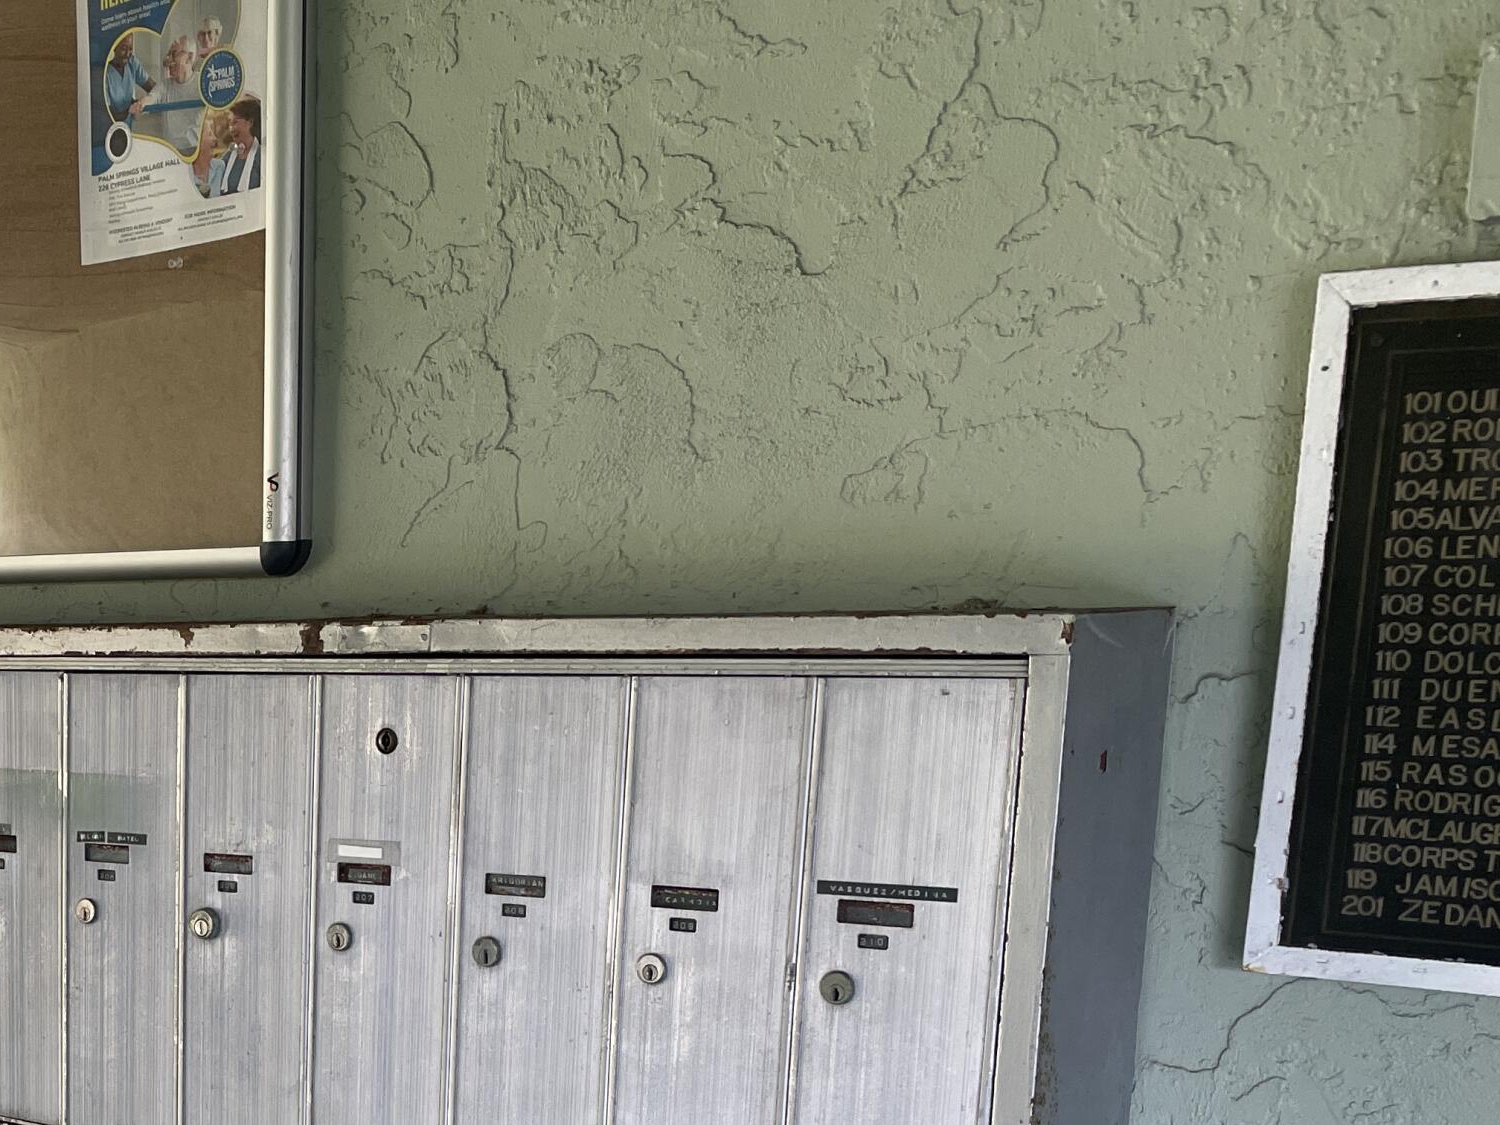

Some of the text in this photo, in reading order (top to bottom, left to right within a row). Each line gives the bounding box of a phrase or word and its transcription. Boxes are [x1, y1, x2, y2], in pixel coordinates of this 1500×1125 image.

[218, 65, 235, 77] PALM
[211, 78, 235, 92] SPRINGS
[98, 158, 180, 182] PALM SPRINGS VILLAGE HALL
[110, 178, 135, 189] CYPRESS
[136, 174, 151, 183] LANE
[1404, 391, 1442, 415] 101
[1402, 420, 1446, 444] 102
[1400, 449, 1443, 473] 103
[1395, 478, 1440, 502] 104
[1391, 505, 1500, 531] 105 ALVA
[1384, 536, 1433, 559] 106
[1385, 564, 1495, 588] 107 COL
[1381, 593, 1500, 616] 108 SCH
[1379, 621, 1422, 645] 109
[1376, 649, 1411, 672] 110
[1372, 677, 1400, 700] 111
[1365, 706, 1401, 728] 112
[1364, 733, 1500, 760] 114 MESA
[1361, 760, 1500, 788] 115 RASO
[1357, 788, 1500, 817] 116 RODRIG
[1352, 816, 1384, 836] 117
[1353, 843, 1382, 863] 118
[1383, 843, 1477, 871] CORPS
[1347, 868, 1377, 890] 119
[1341, 896, 1384, 918] 201
